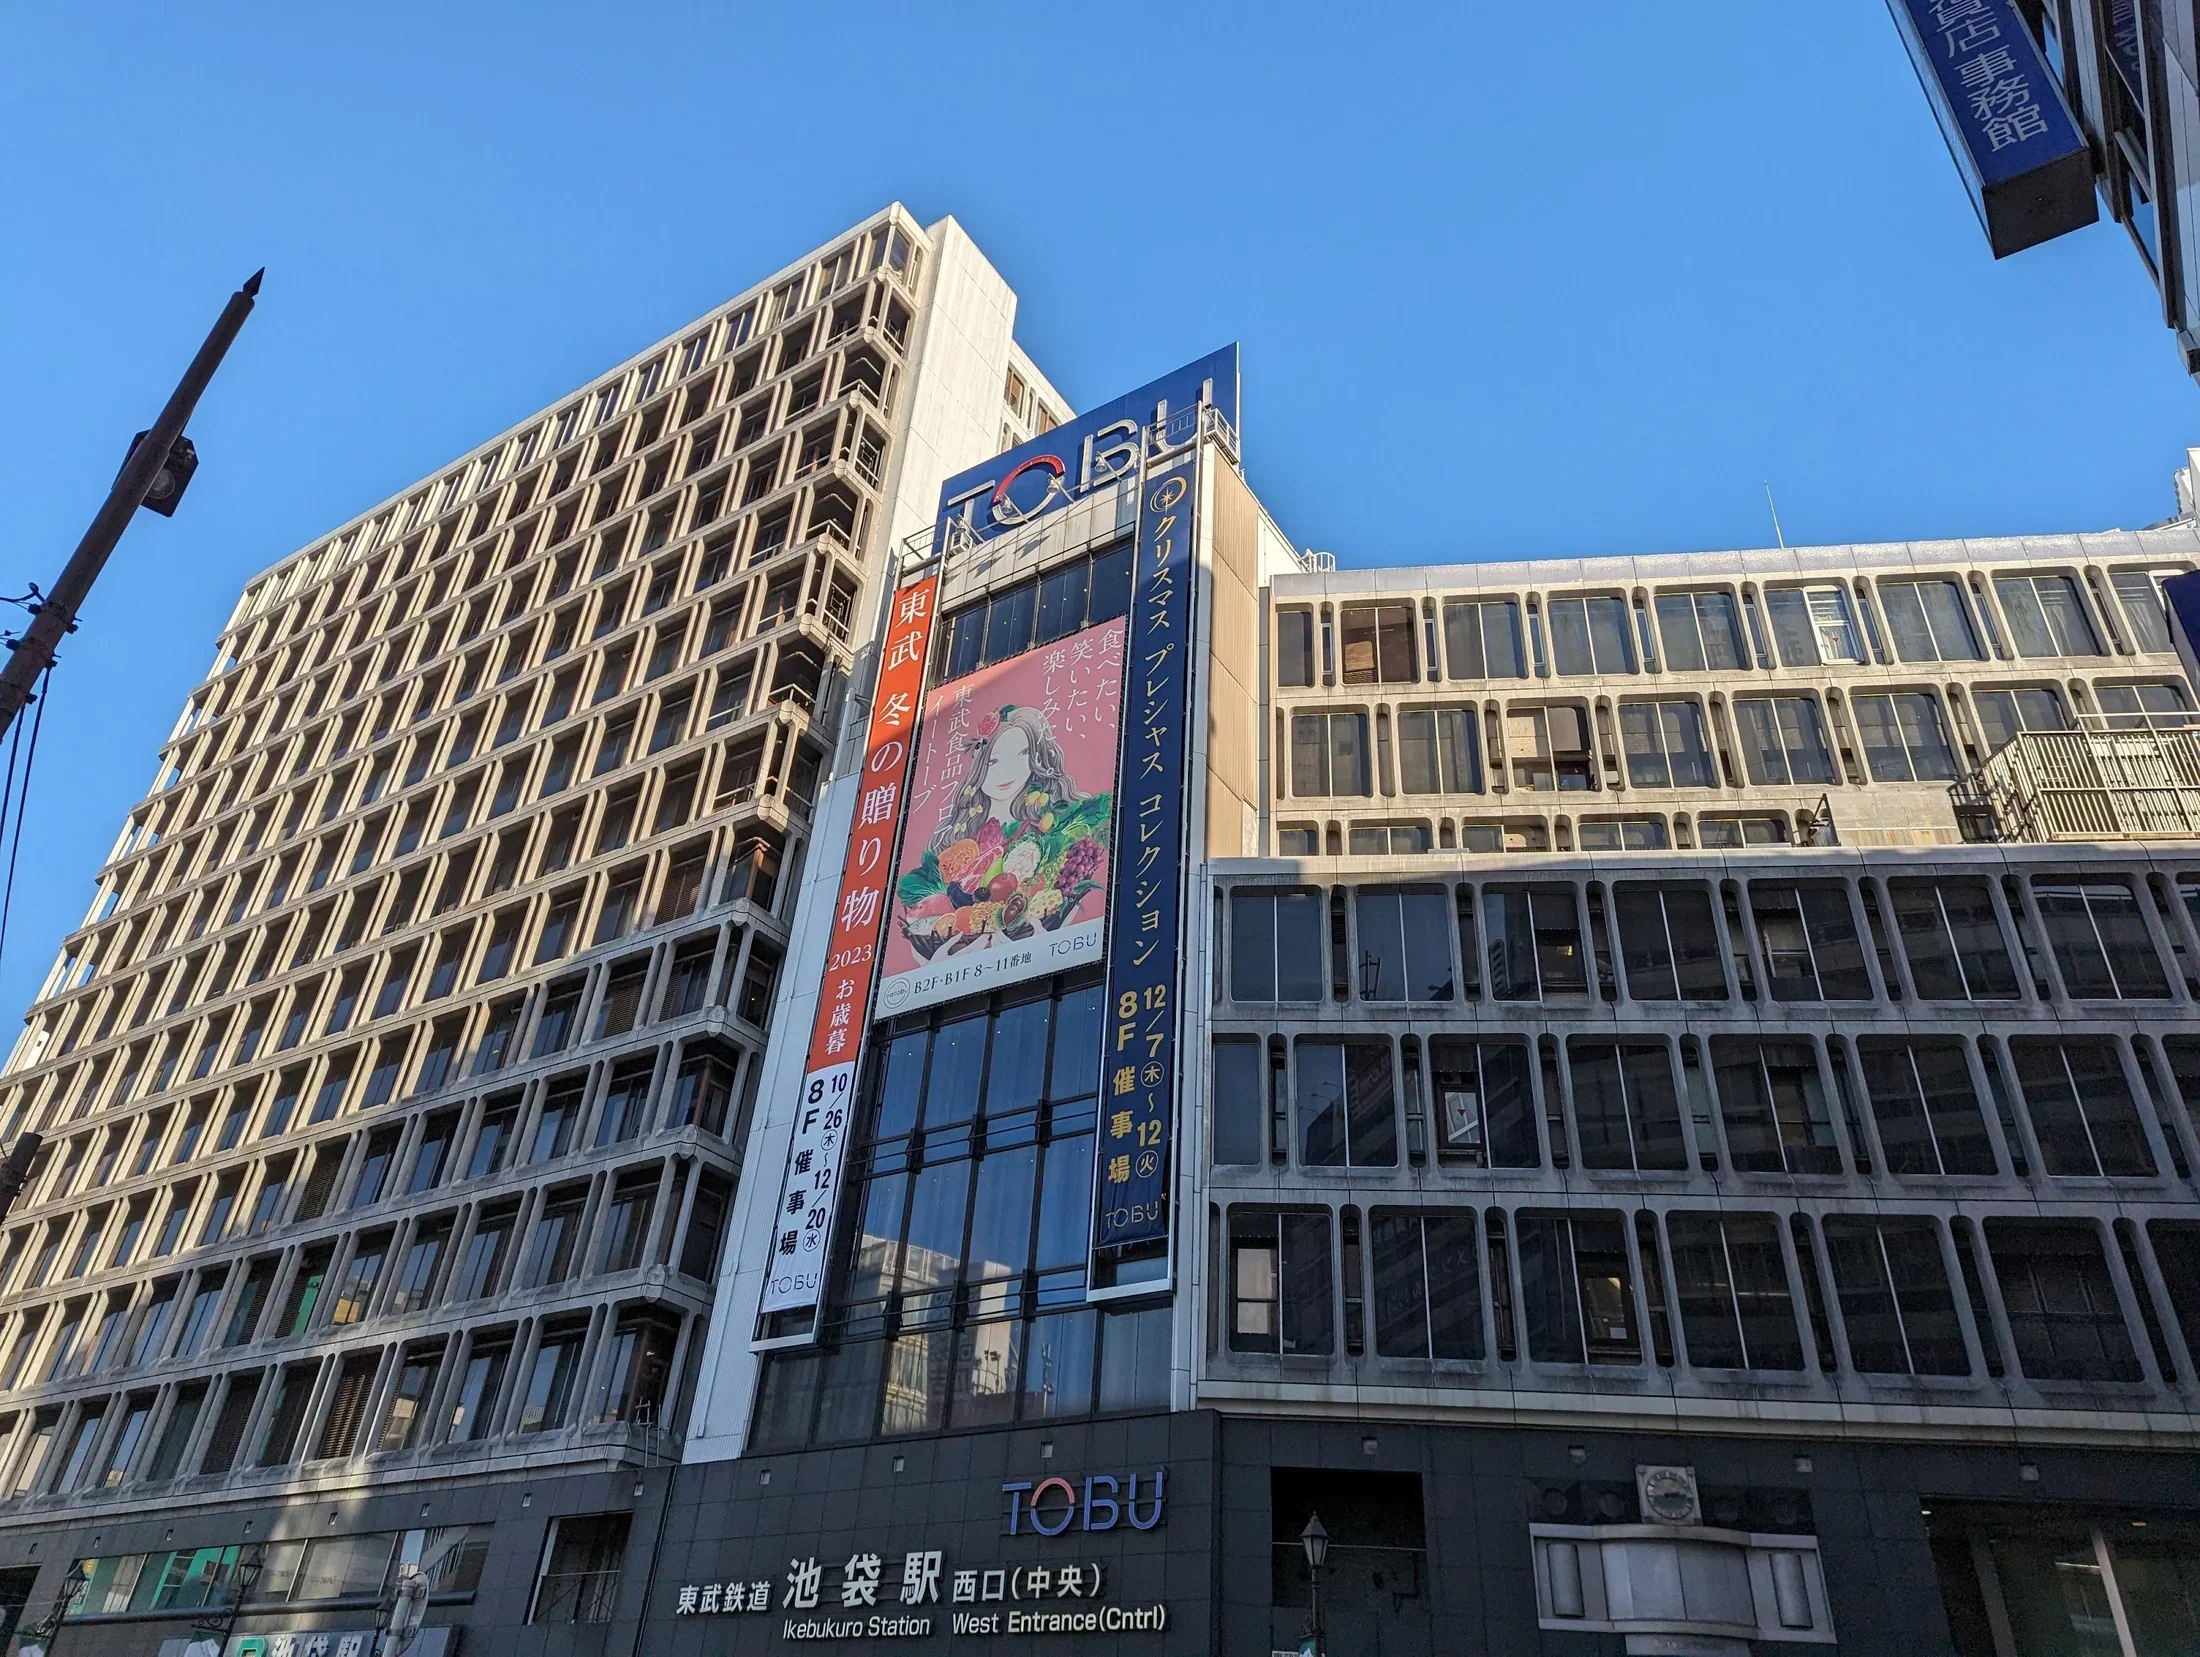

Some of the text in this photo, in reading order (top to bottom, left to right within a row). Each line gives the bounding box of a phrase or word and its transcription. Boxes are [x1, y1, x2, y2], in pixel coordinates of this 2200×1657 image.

[947, 378, 1213, 530] TOBU
[1035, 648, 1066, 777] 楽しみたい。
[1065, 638, 1094, 739] 笑いたい、
[1094, 629, 1124, 729] 食べたい、
[841, 588, 930, 932] 東武 冬の贈り物
[913, 694, 943, 813] イートーブ
[933, 683, 974, 850] 東武食品フロア
[1133, 516, 1175, 967] クリスマス プレシャス コレクション
[825, 944, 872, 1055] 2023 お歳暮
[1049, 932, 1097, 956] TOBU
[1108, 990, 1138, 1183] 8F 催事場
[778, 1079, 824, 1256] 8F 催事場
[1106, 1201, 1159, 1231] TOBU
[771, 1272, 818, 1295] TOBU
[1002, 1471, 1163, 1536] TOBU
[676, 1580, 771, 1615] 東武鉄道
[782, 1551, 942, 1609] 池袋駅
[782, 1618, 863, 1640] Ikebukuro
[867, 1615, 930, 1637] Station
[952, 1613, 1000, 1634] West
